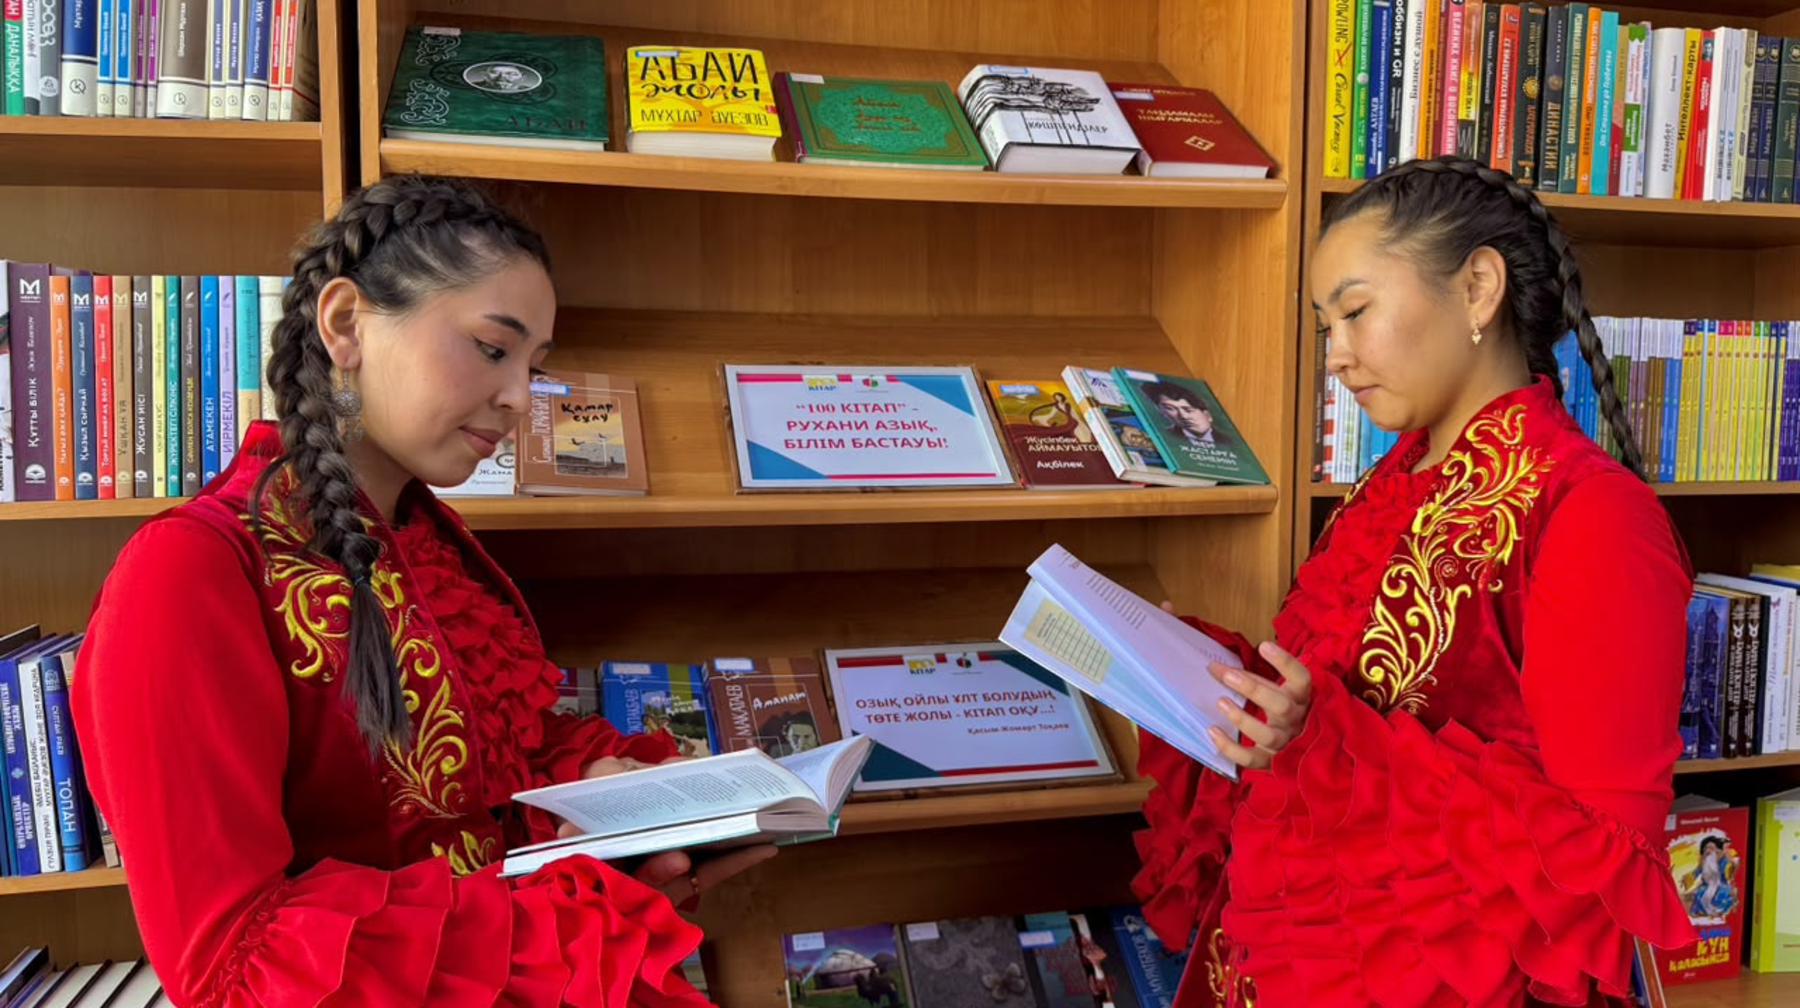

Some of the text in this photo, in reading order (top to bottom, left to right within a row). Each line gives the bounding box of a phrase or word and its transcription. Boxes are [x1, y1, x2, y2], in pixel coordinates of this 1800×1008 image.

[1394, 0, 1404, 45] оббизм
[640, 51, 759, 84] АБАЙ
[1392, 59, 1402, 78] GR
[1678, 39, 1697, 141] Интеллект-карты
[1544, 102, 1560, 170] ДИНАСТИИ
[205, 397, 216, 452] АТАМЕКЕН
[786, 420, 869, 432] РУХАНИ
[784, 437, 948, 450] БІЛІМ БАСТАУЫ!
[855, 690, 1057, 710] ОЗЫҚ ОЙЛЫ ҰЛТ БОЛУДЫҢ
[864, 713, 901, 725] ТӨТЕ
[904, 710, 953, 722] ЖОЛЫ
[963, 707, 1006, 719] КІТАП
[57, 777, 77, 833] ТОПАН
